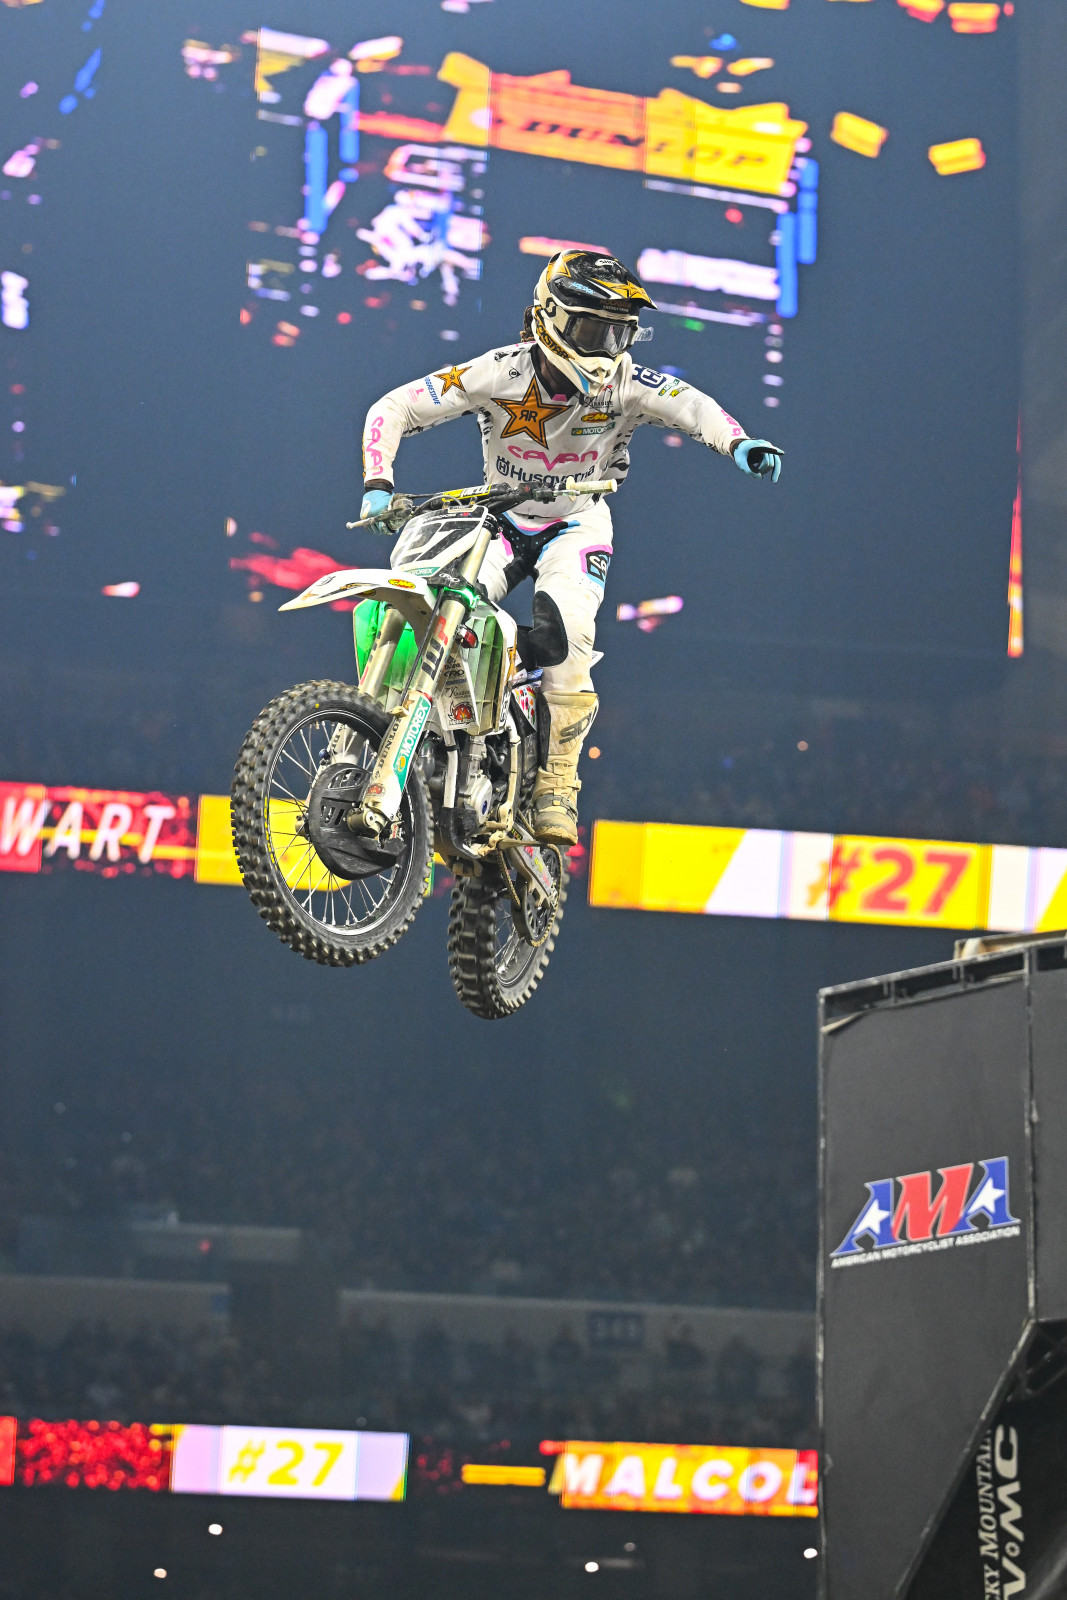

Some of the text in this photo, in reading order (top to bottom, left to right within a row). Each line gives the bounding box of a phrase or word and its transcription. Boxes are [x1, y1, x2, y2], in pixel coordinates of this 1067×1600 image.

[510, 464, 595, 486] Husqvarna
[401, 702, 430, 758] MOTOREX
[806, 841, 971, 917] #27
[829, 1156, 1021, 1258] AMA
[955, 1225, 1021, 1247] ASSOCIATION
[228, 1438, 344, 1487] #27
[975, 1428, 1000, 1561] MOUNTAI
